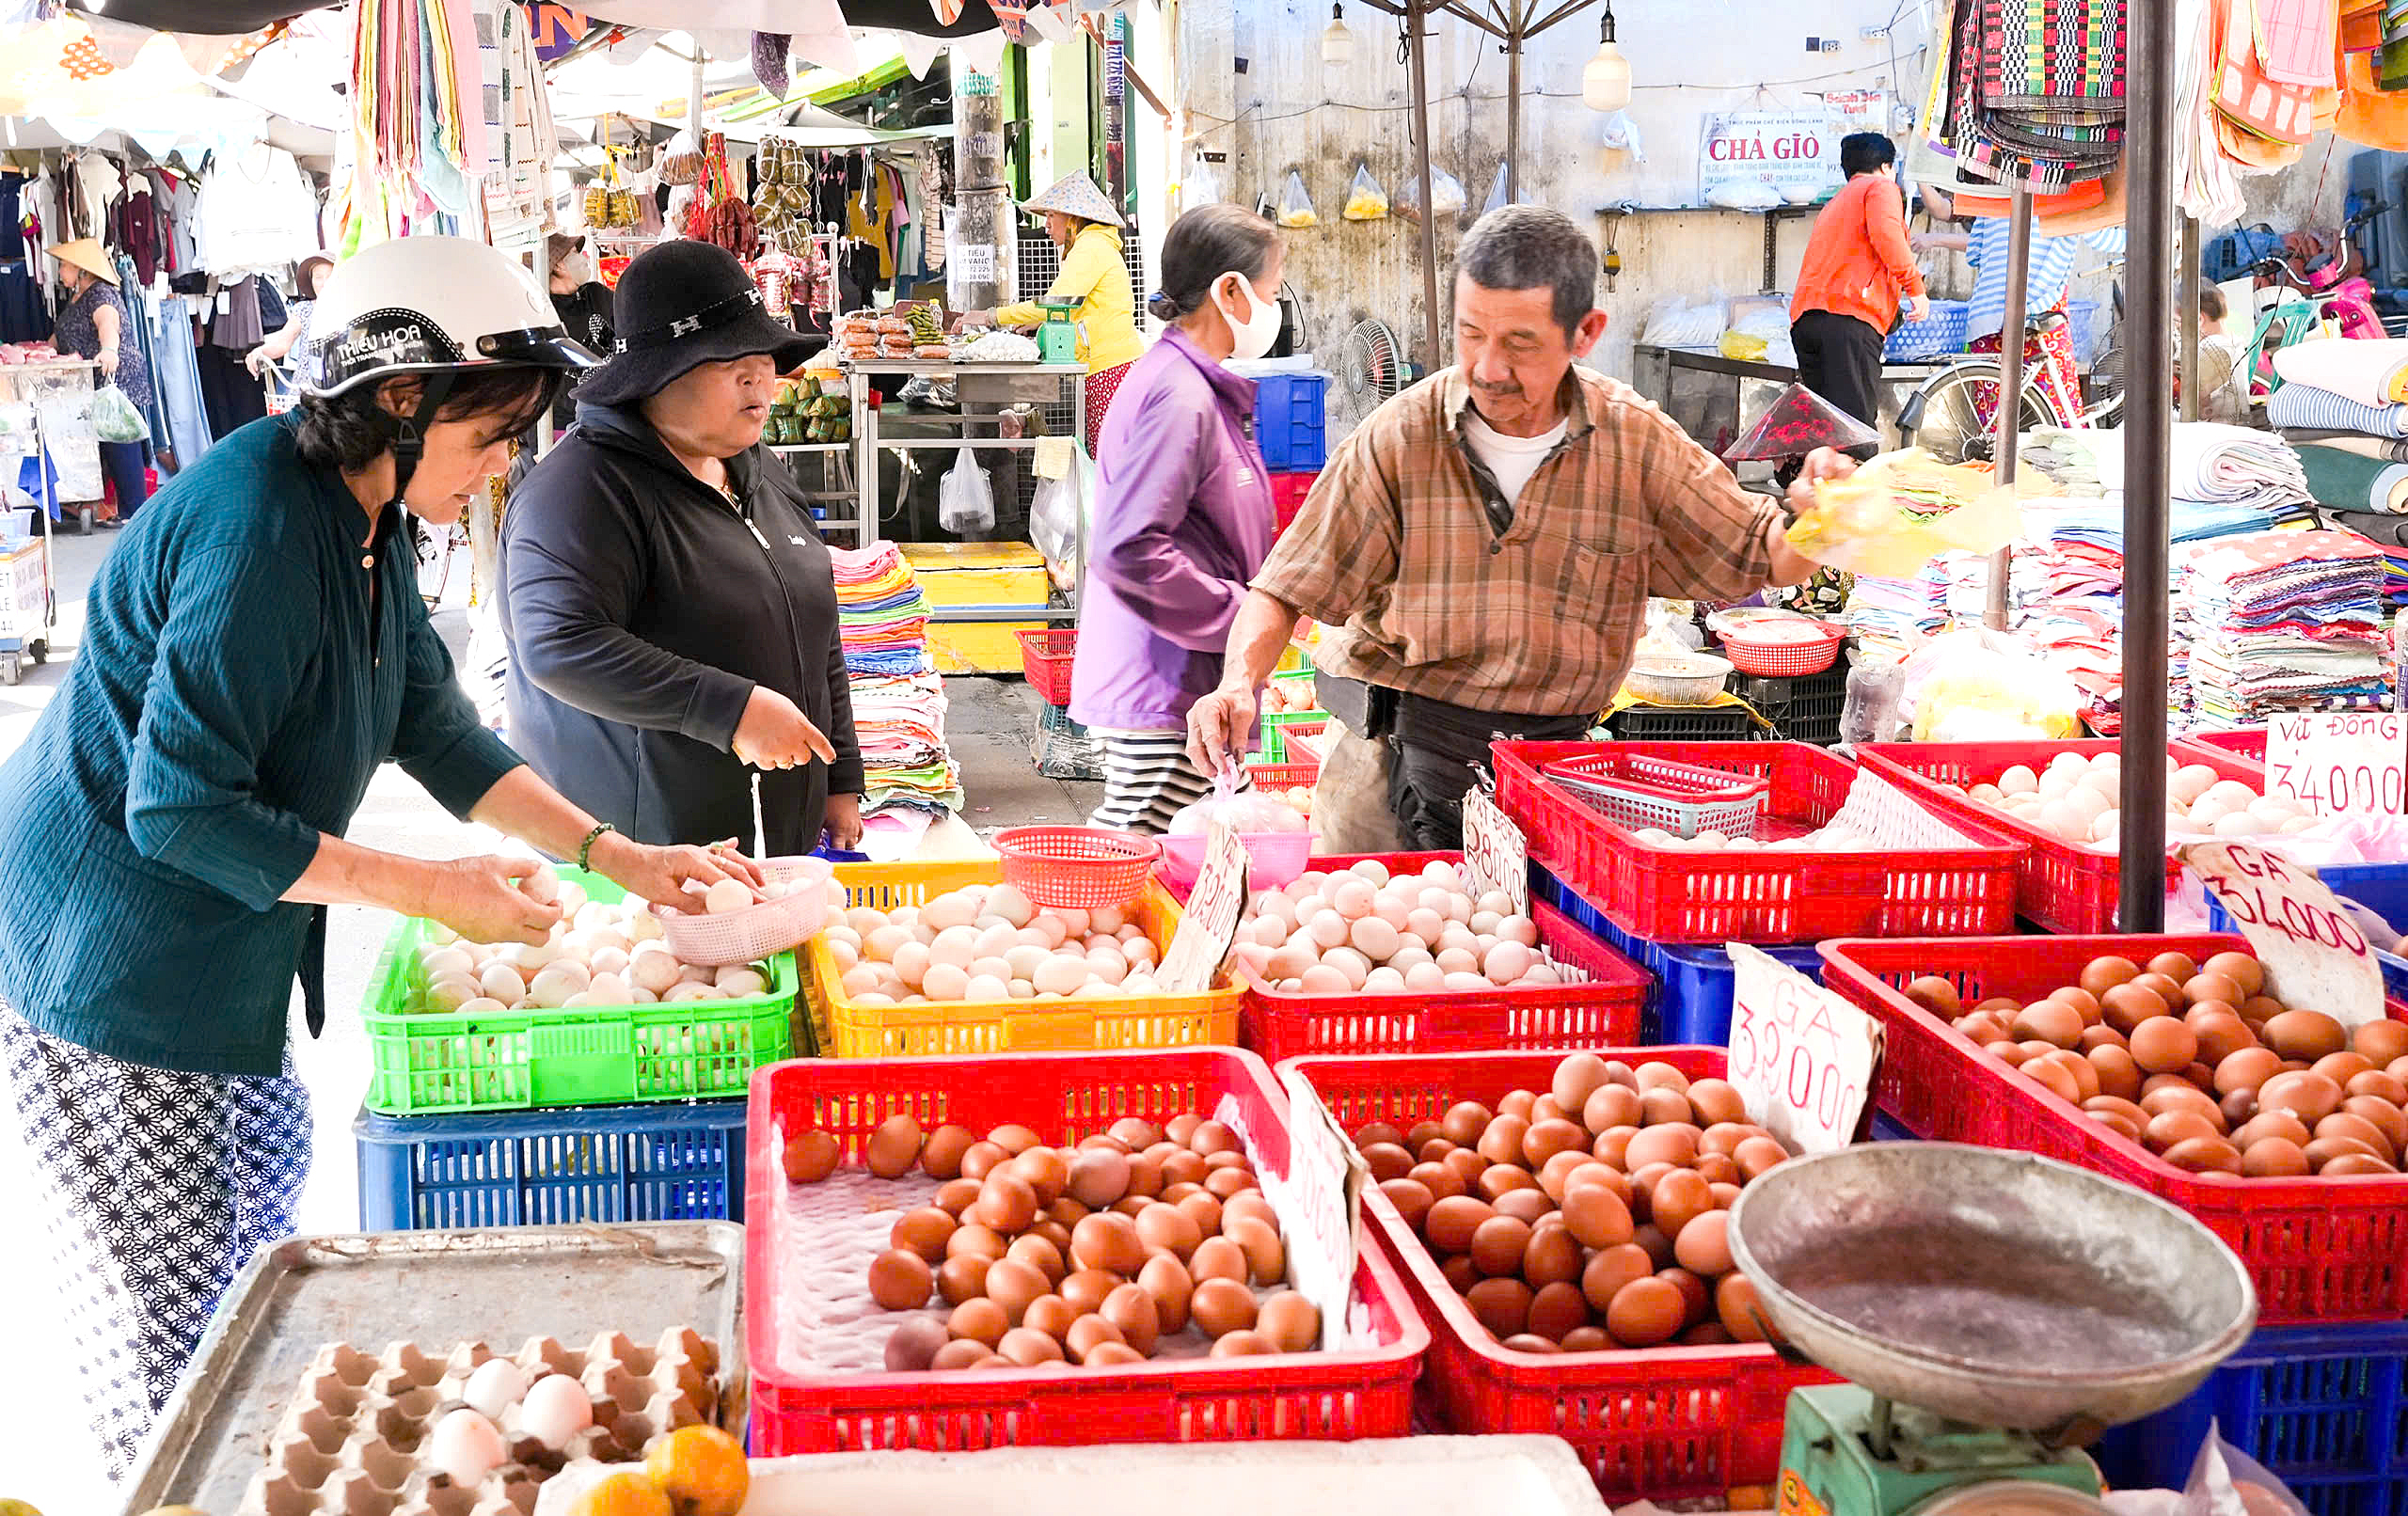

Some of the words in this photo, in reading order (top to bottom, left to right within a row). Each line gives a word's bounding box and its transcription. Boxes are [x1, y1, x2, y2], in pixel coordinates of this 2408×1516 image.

[1709, 129, 1766, 161] CHẢ
[381, 324, 421, 349] HOA
[1465, 820, 1522, 907] 28000
